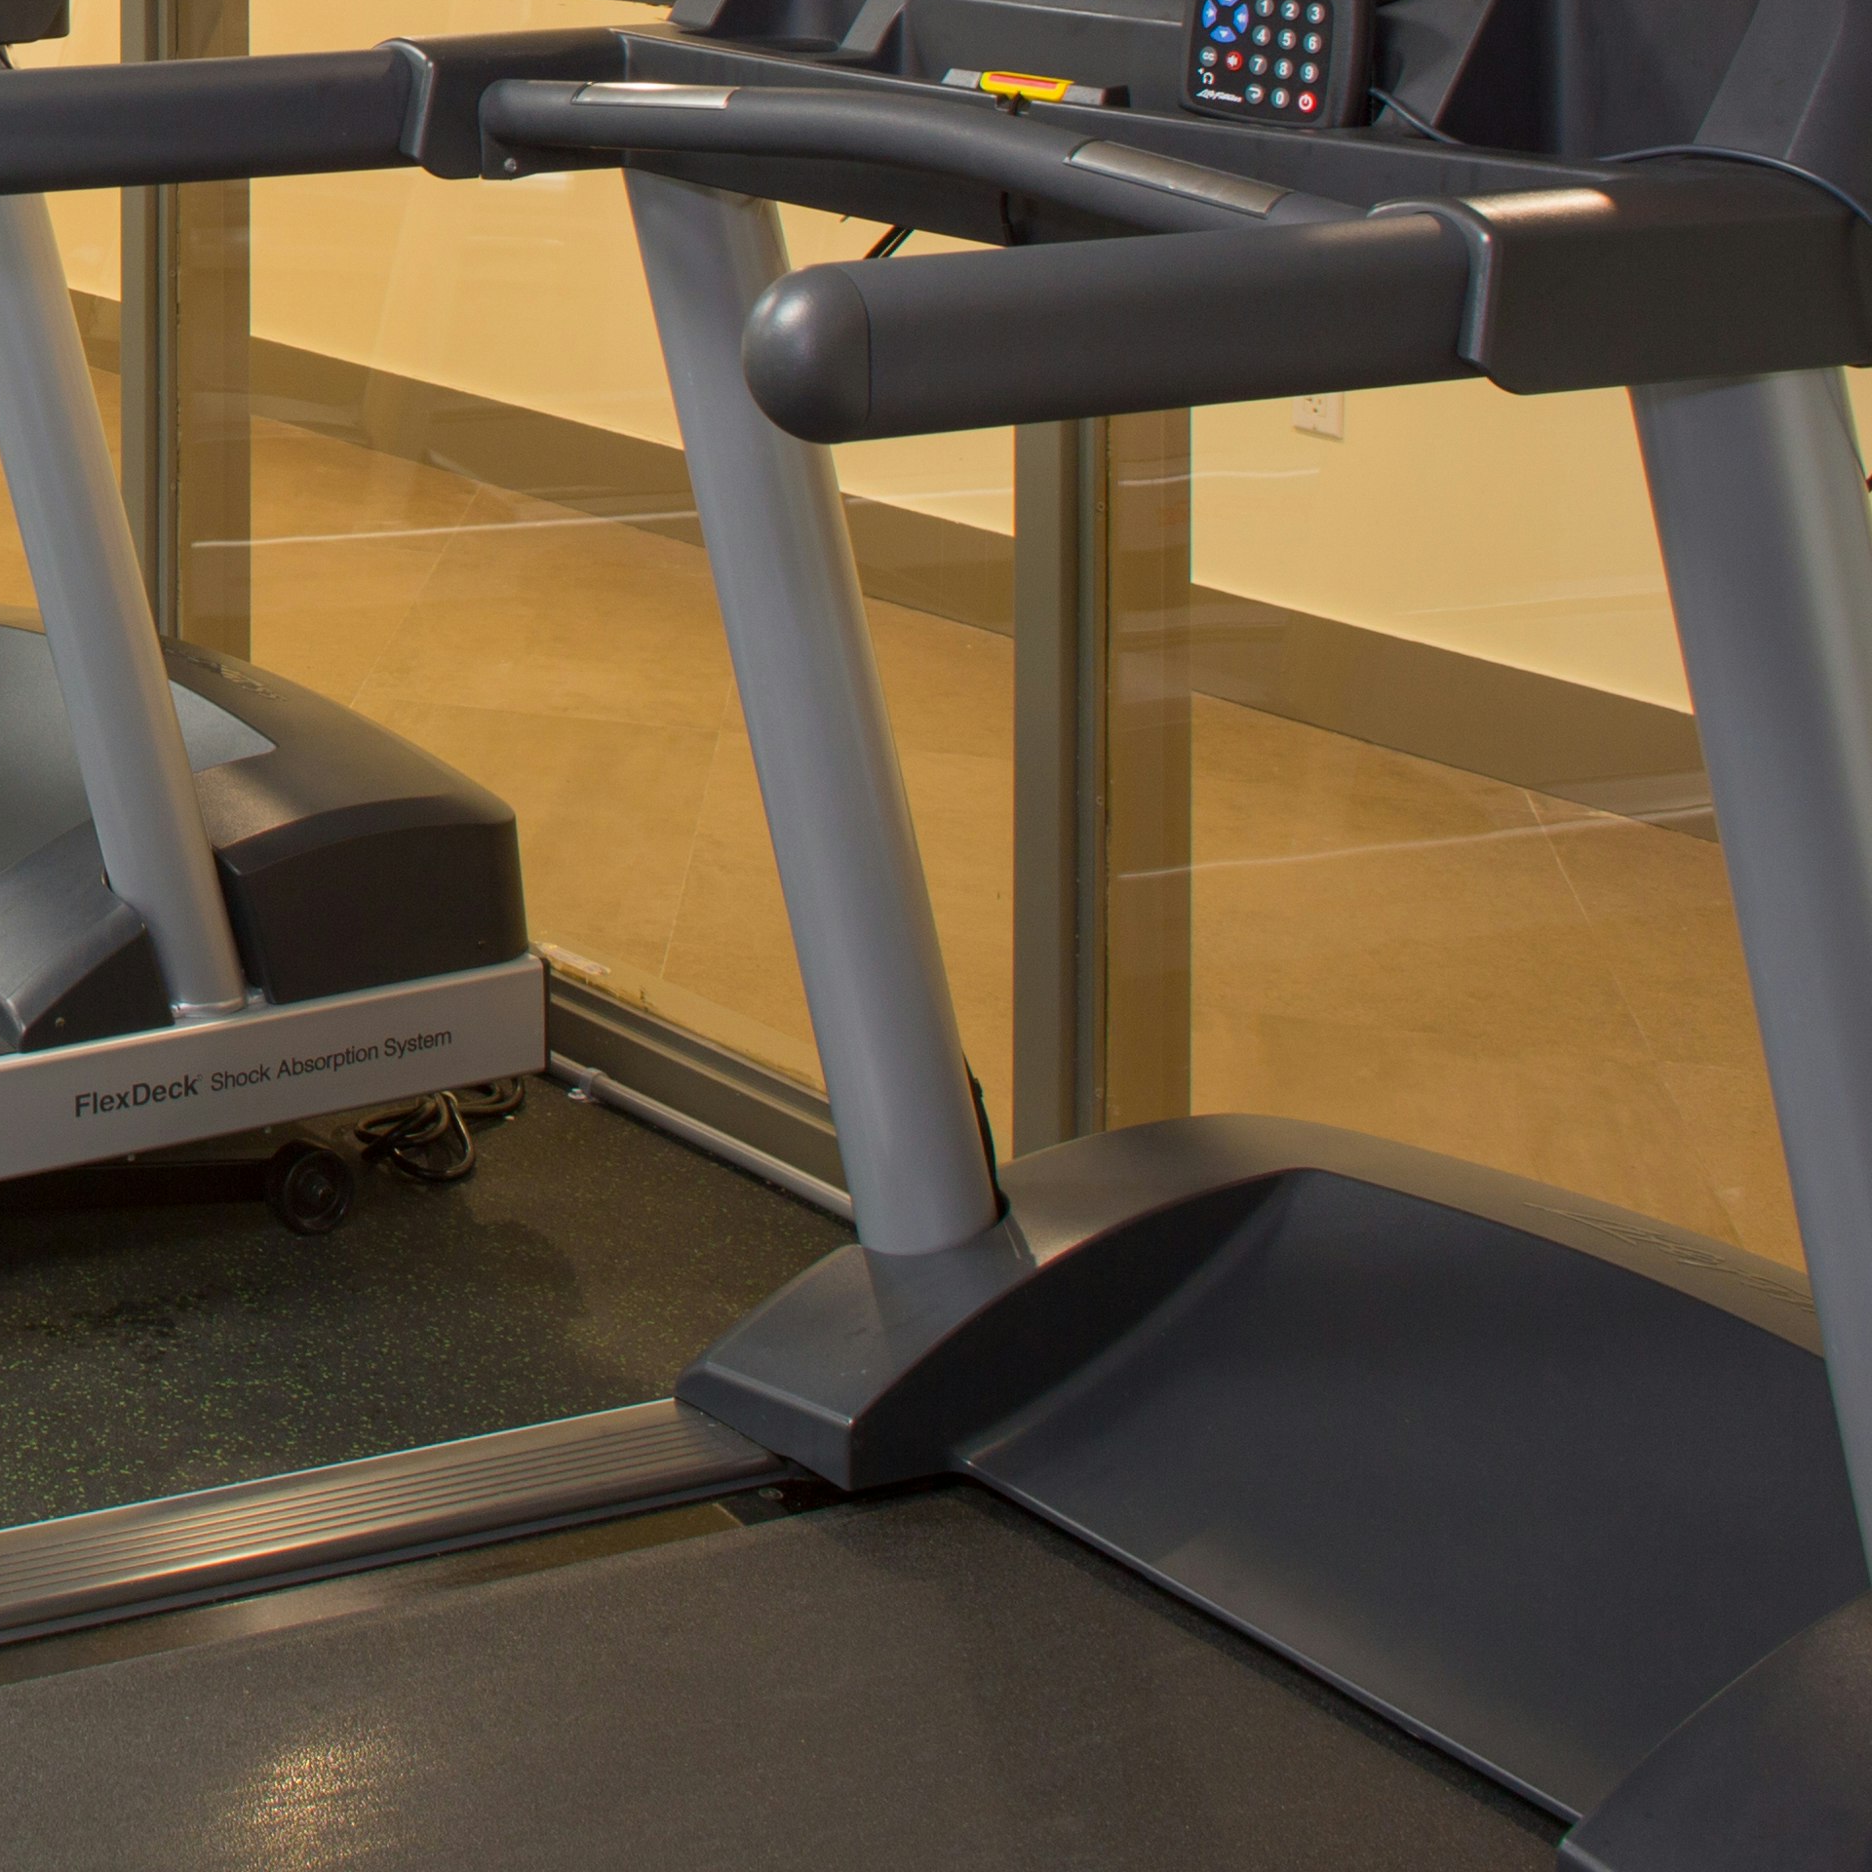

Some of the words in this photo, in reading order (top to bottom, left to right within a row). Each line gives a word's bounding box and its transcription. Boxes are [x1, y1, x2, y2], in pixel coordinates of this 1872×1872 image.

[75, 1074, 199, 1117] FlexDeck
[210, 1063, 271, 1092] Shock
[277, 1045, 379, 1079] Absorption
[384, 1029, 452, 1060] System
